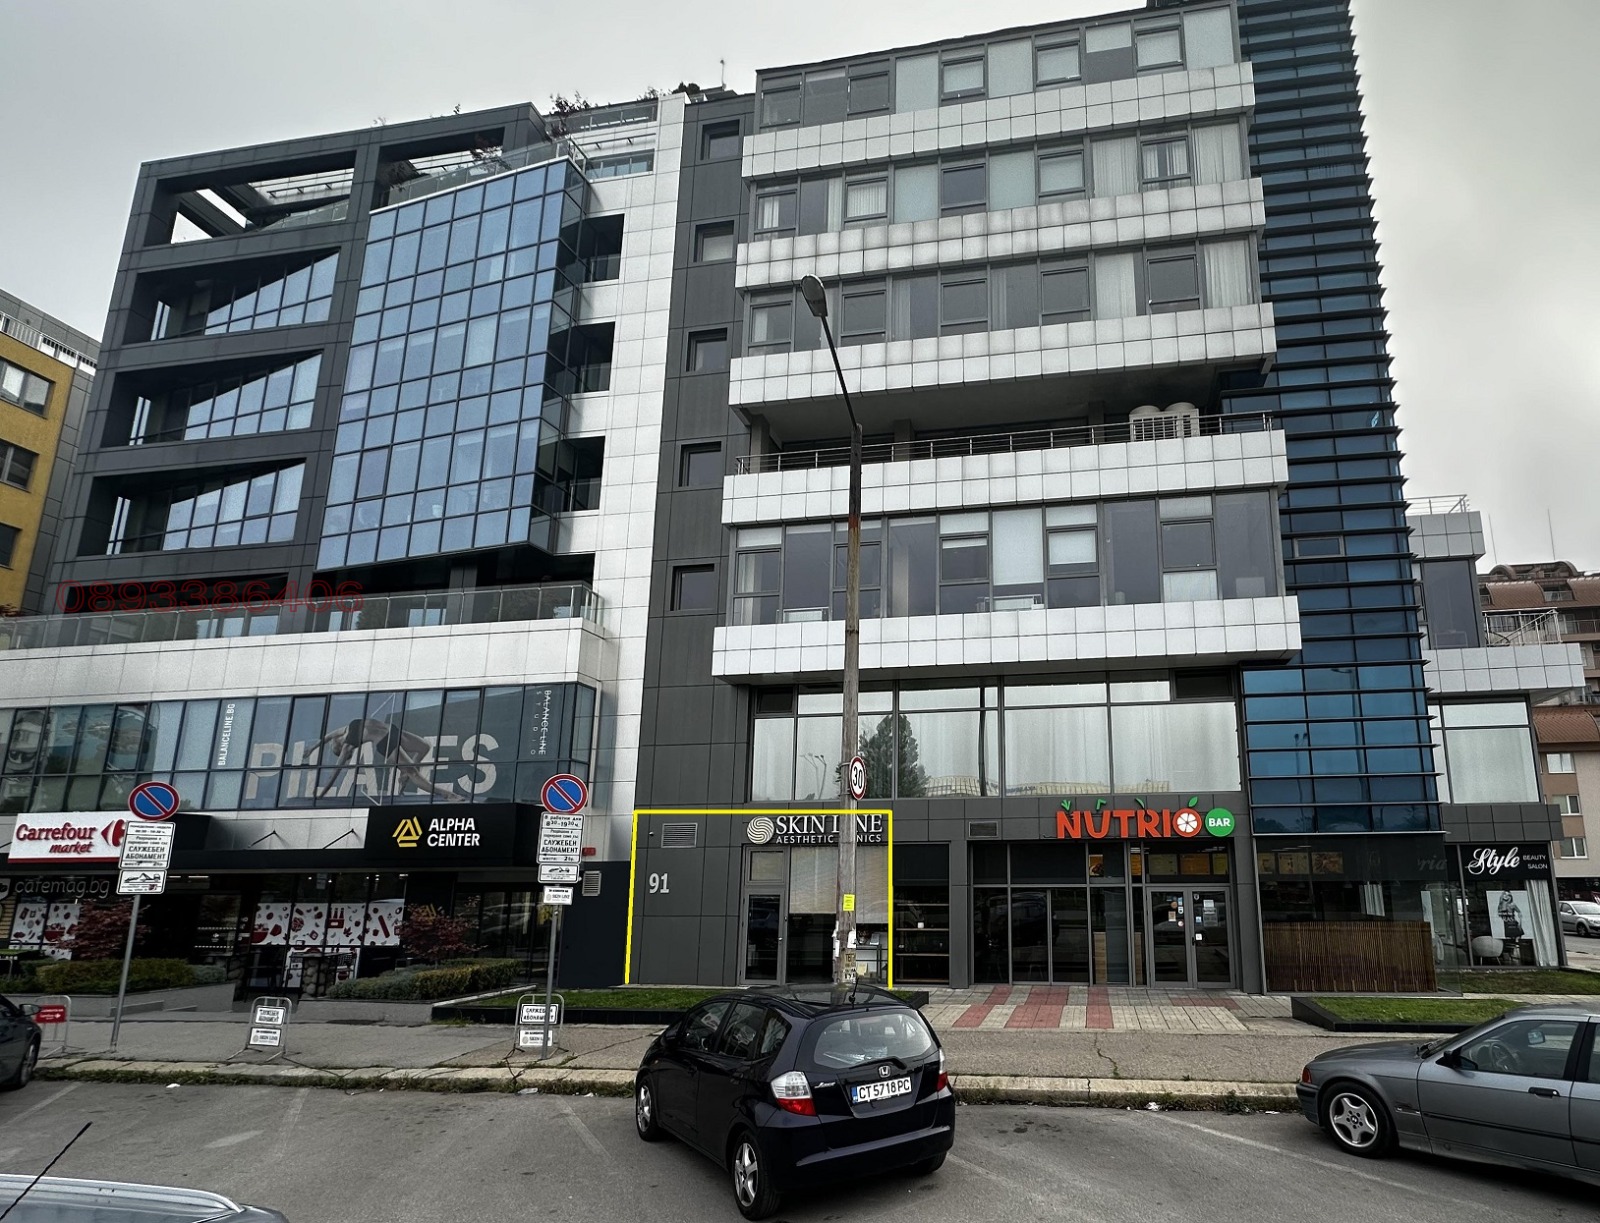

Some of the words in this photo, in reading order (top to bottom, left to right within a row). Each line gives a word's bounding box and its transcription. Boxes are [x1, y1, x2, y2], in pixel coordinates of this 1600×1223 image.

[218, 703, 236, 766] BALANCELINE.BG
[852, 766, 863, 789] 30
[16, 822, 98, 841] Carrefour
[428, 817, 476, 832] ALPHA
[775, 814, 826, 835] SKIN
[831, 813, 883, 834] LNE
[1056, 807, 1203, 839] NUTRIO
[1208, 817, 1231, 828] BAR
[49, 842, 94, 855] market
[427, 832, 480, 847] CENTER
[543, 839, 577, 847] СЛУЖЕБЕН
[776, 834, 834, 844] AESTHETIC
[128, 845, 165, 853] СЛУЖЕБЕН
[1465, 846, 1520, 875] Style
[649, 872, 670, 894] 91
[859, 1086, 872, 1099] CT
[873, 1082, 897, 1096] 5718
[897, 1079, 910, 1092] PC
